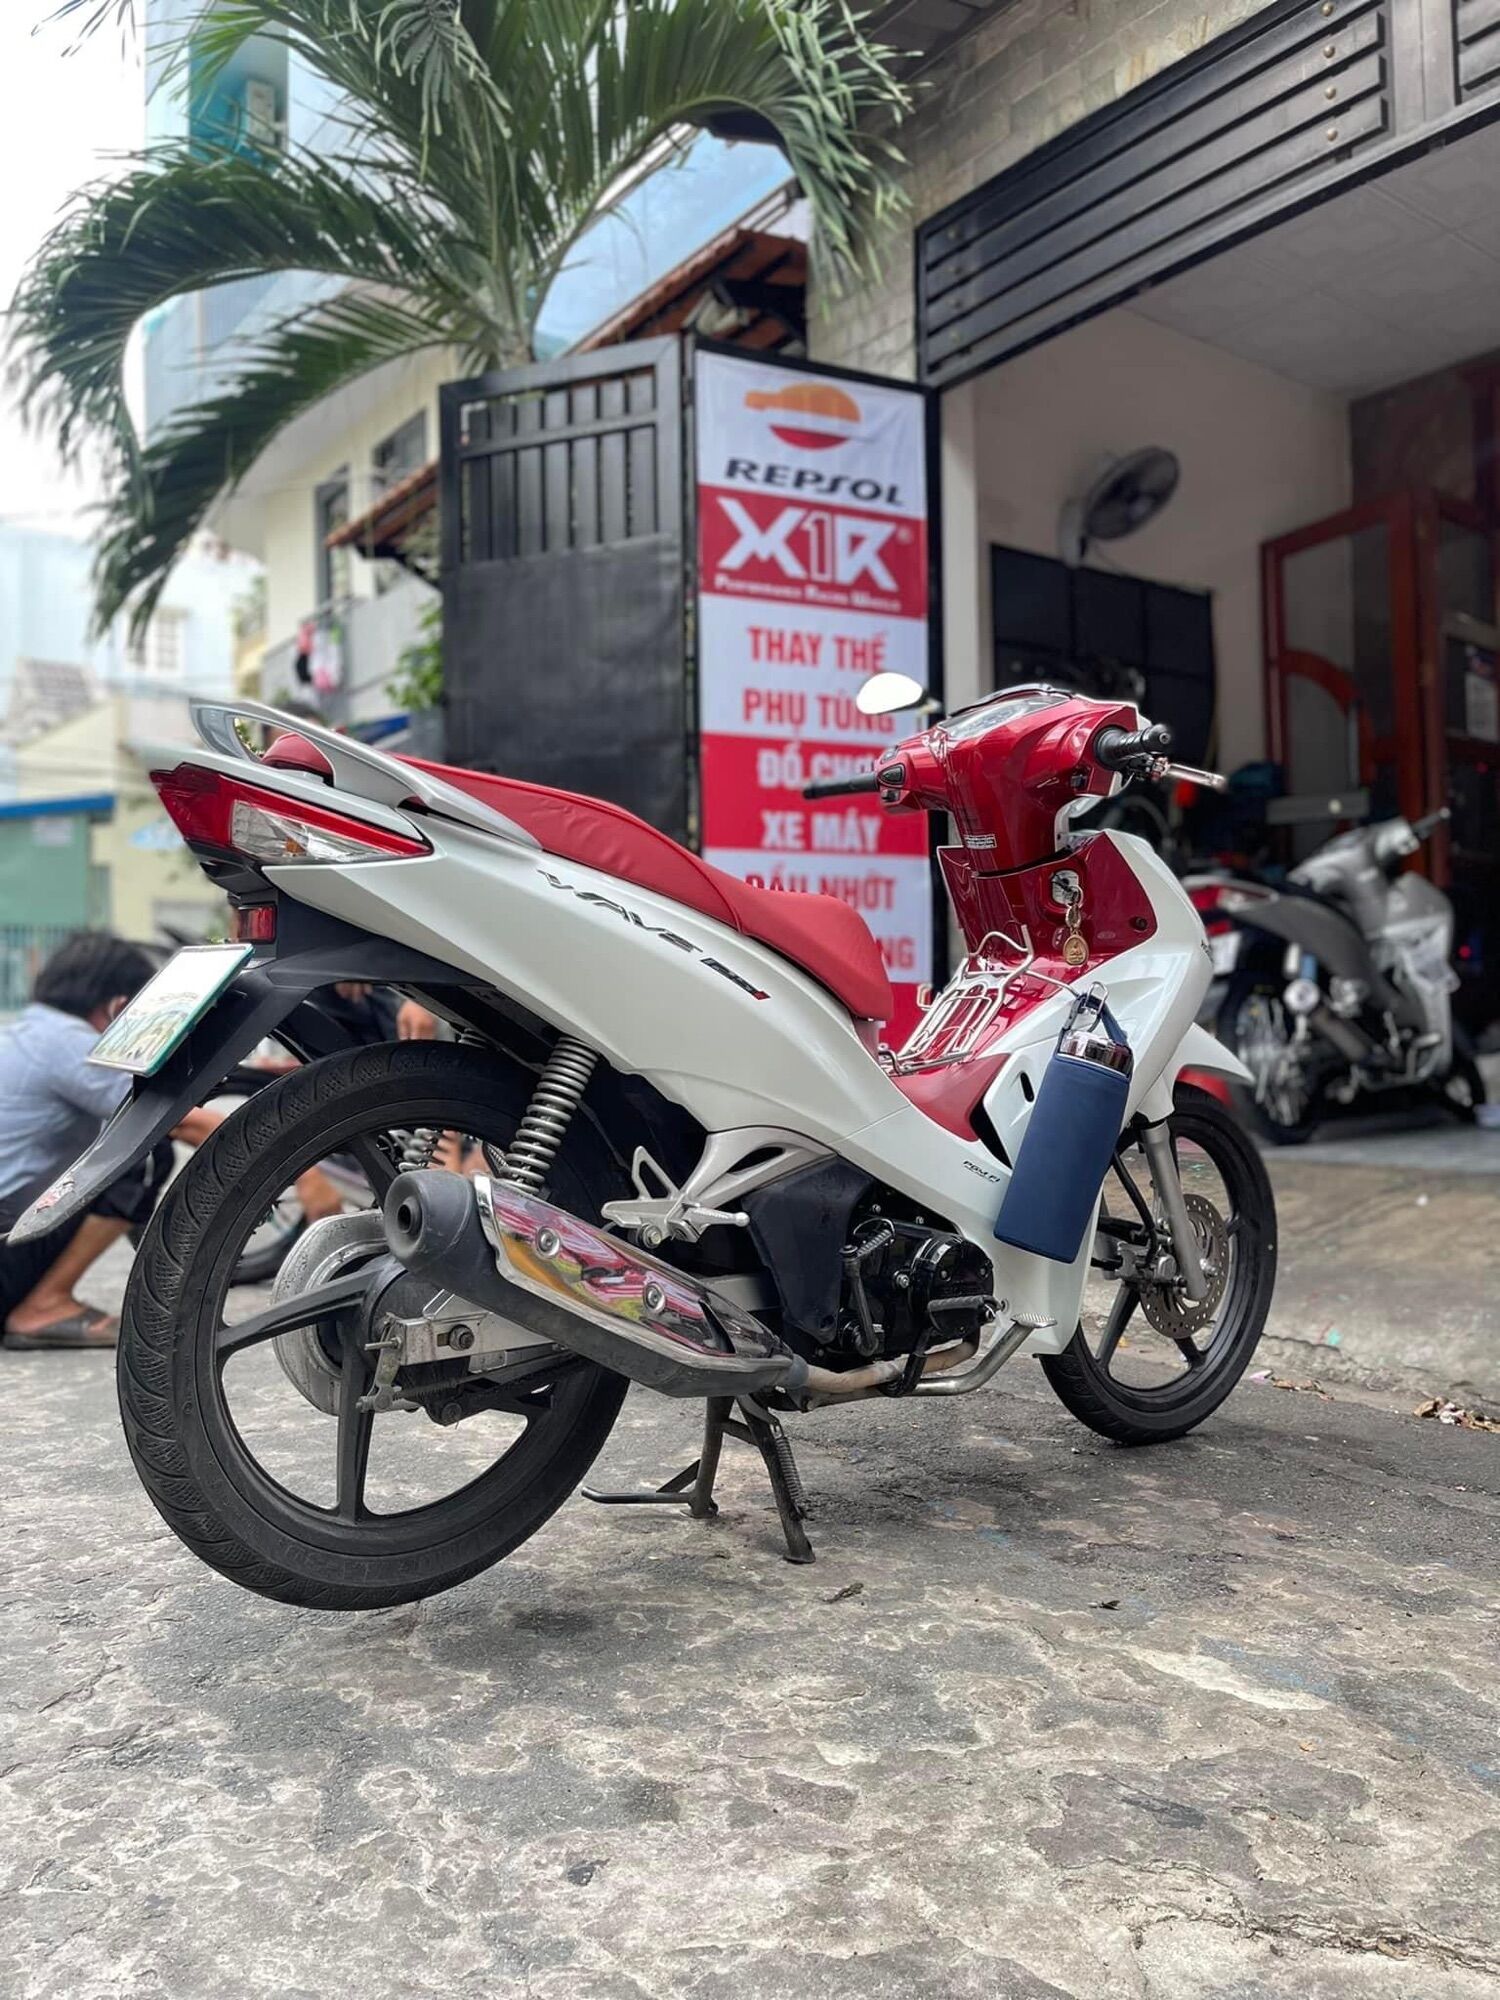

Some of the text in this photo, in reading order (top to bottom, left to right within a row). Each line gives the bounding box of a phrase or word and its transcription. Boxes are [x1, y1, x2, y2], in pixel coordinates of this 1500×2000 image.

[725, 457, 904, 507] REPSOL
[716, 495, 899, 592] X1R
[748, 627, 821, 666] THAY
[744, 689, 804, 732] PHỤ
[763, 809, 880, 851] XE MÁY
